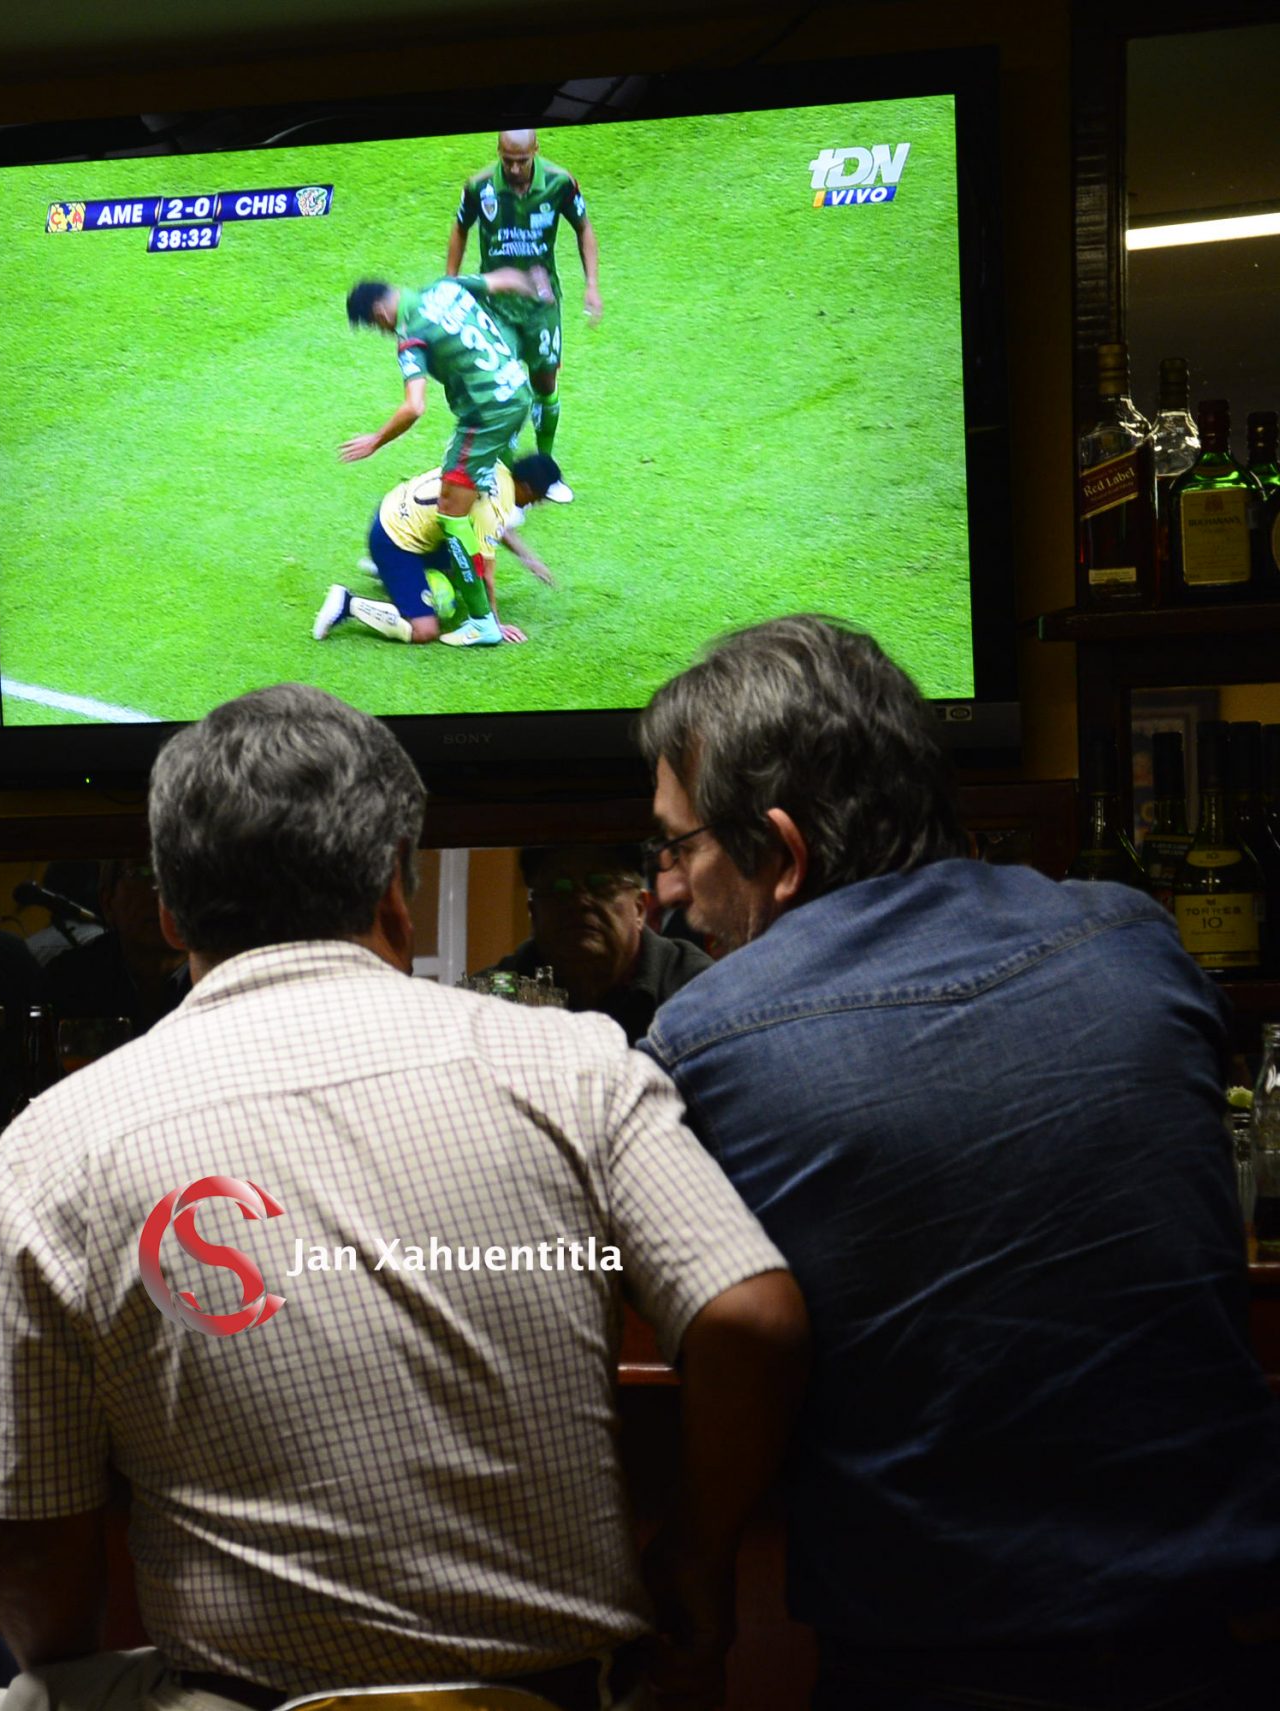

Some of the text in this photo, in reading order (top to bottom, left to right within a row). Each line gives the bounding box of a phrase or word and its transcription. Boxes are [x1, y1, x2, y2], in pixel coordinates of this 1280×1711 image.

[831, 187, 888, 205] VIVO
[96, 194, 287, 226] AME 2-0 CHIS
[156, 228, 212, 249] 38:32
[1083, 479, 1105, 498] Red
[1106, 467, 1136, 488] Label
[443, 732, 493, 745] SONY
[1201, 917, 1223, 929] 10
